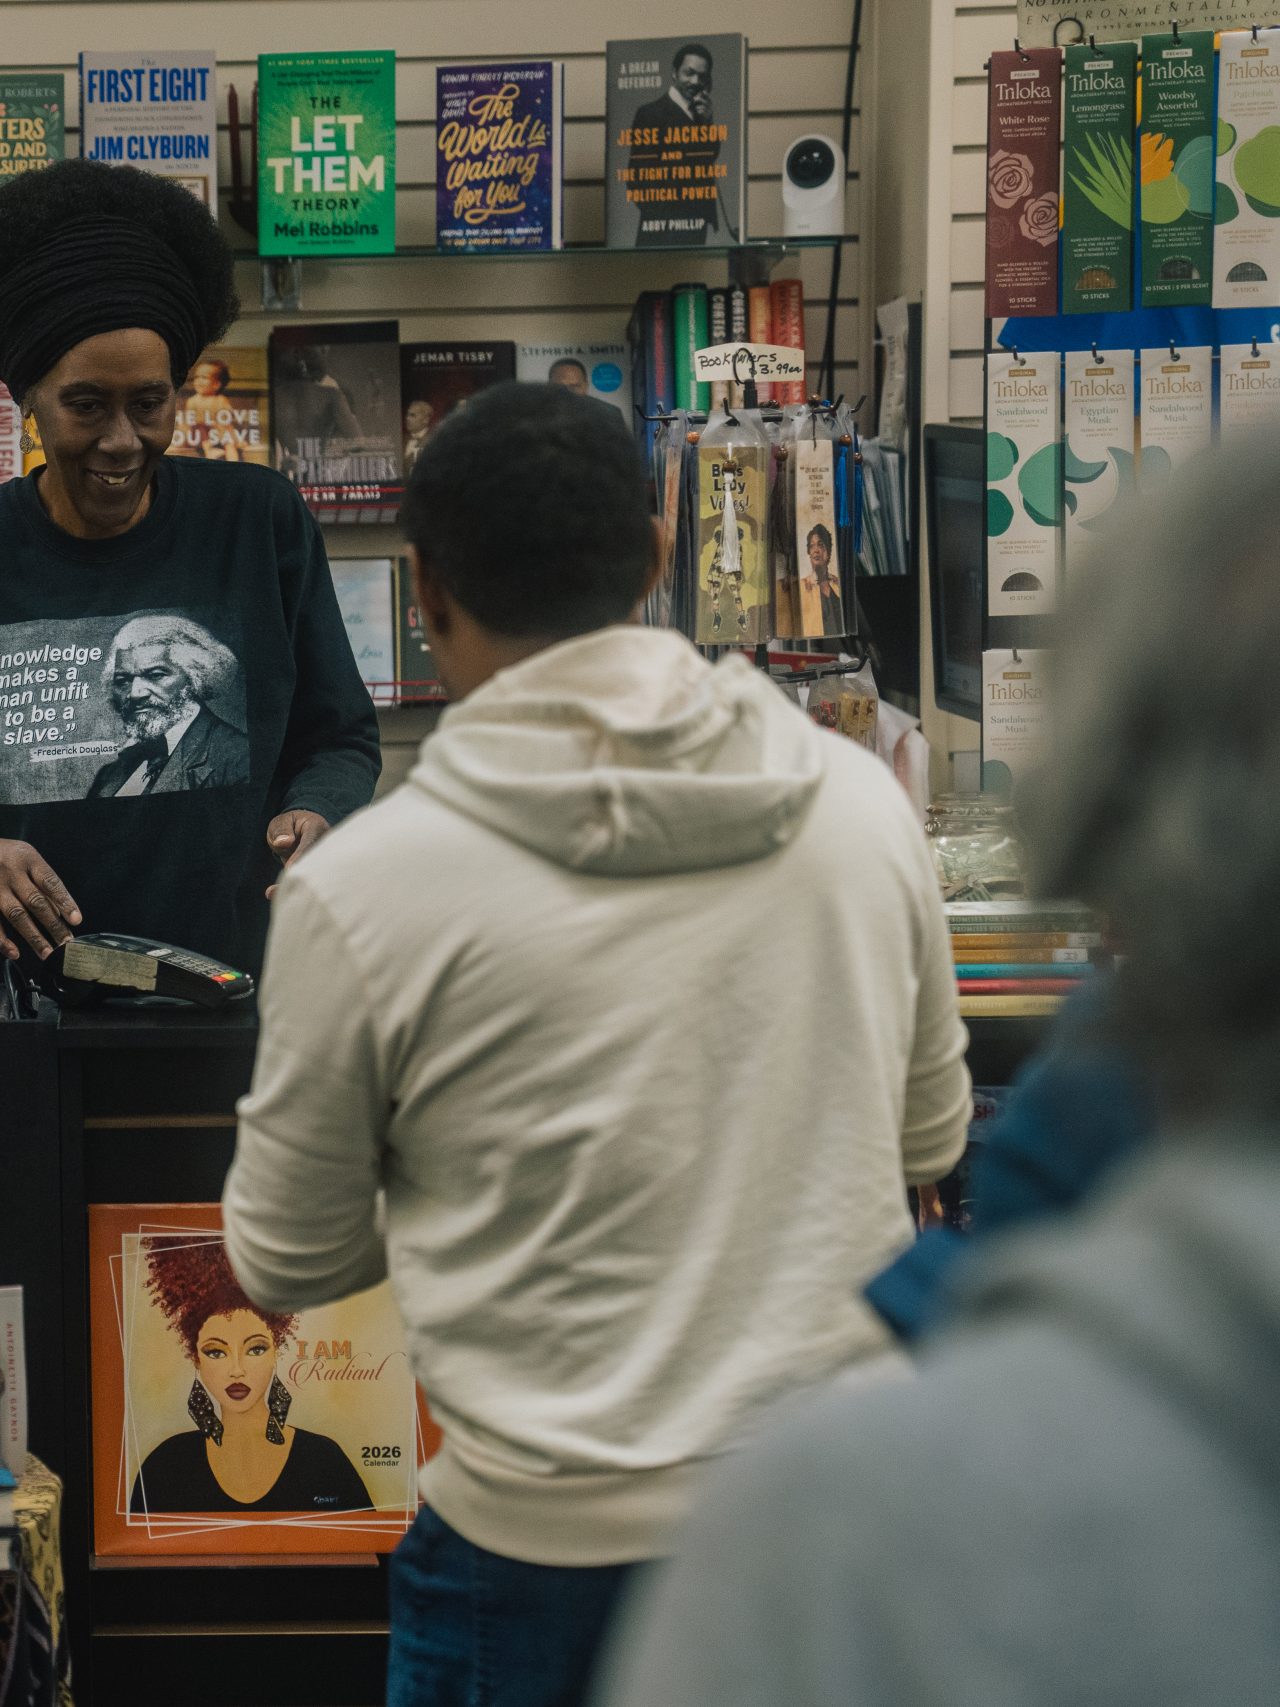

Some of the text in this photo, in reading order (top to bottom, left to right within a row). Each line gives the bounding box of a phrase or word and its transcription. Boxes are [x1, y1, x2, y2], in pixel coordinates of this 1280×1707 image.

[1204, 12, 1255, 23] TRADING
[621, 61, 660, 75] A DREAM
[88, 67, 209, 103] FIRST EIGHT
[618, 75, 662, 90] DEFERRED
[4, 86, 57, 98] ROBERTS
[1158, 90, 1196, 101] Woodsy
[309, 96, 341, 109] THE
[469, 83, 520, 126] The
[1071, 103, 1125, 113] Lemongrass
[1156, 99, 1198, 111] Assorted
[999, 115, 1050, 125] White Rose
[290, 115, 363, 152] LET
[438, 115, 531, 162] World
[616, 123, 728, 146] JESSE JACKSON
[12, 142, 47, 158] AND
[89, 134, 209, 160] JIM CLYBURN
[661, 151, 683, 161] AND
[266, 155, 385, 194] THEM
[446, 152, 539, 190] Waiting
[616, 163, 728, 182] THE FIGHT FOR BLACK
[626, 185, 717, 203] POLITICAL POWER
[292, 198, 360, 212] THEORY
[454, 186, 482, 220] for
[274, 220, 379, 238] Mel Robbins
[642, 217, 705, 231] ABBY PHILLIP
[413, 350, 494, 364] JEMAR TISBY
[996, 406, 1048, 416] Sandalwood
[1080, 406, 1119, 416] Egyptian
[1148, 403, 1203, 414] Sandalwood
[204, 409, 259, 427] LOVE
[1087, 416, 1111, 425] Musk
[208, 428, 260, 446] SAVE
[66, 667, 78, 681] a
[40, 681, 90, 702] unfit
[5, 706, 75, 727] to be a
[32, 744, 119, 757] -Frederick Douglass
[295, 1340, 352, 1360] I AM
[287, 1351, 407, 1388] Radiant
[9, 1394, 19, 1442] GAYNOR
[361, 1446, 402, 1460] 2026
[363, 1459, 400, 1467] Calendar
